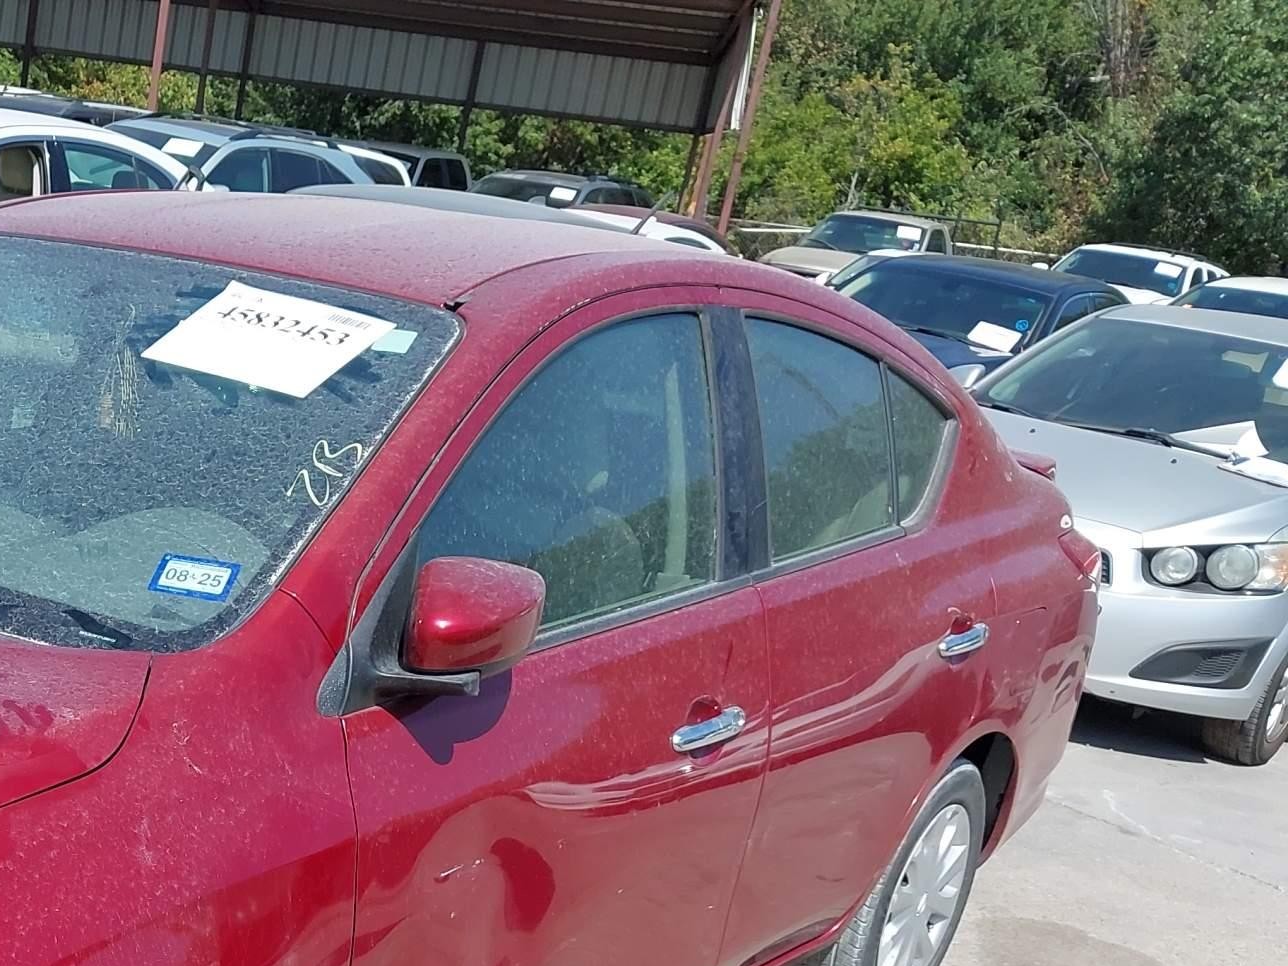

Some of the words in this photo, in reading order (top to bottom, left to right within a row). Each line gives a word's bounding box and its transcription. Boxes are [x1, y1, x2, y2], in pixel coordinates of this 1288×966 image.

[218, 306, 351, 346] 45832453
[165, 567, 190, 583] 08
[197, 573, 224, 588] 25
